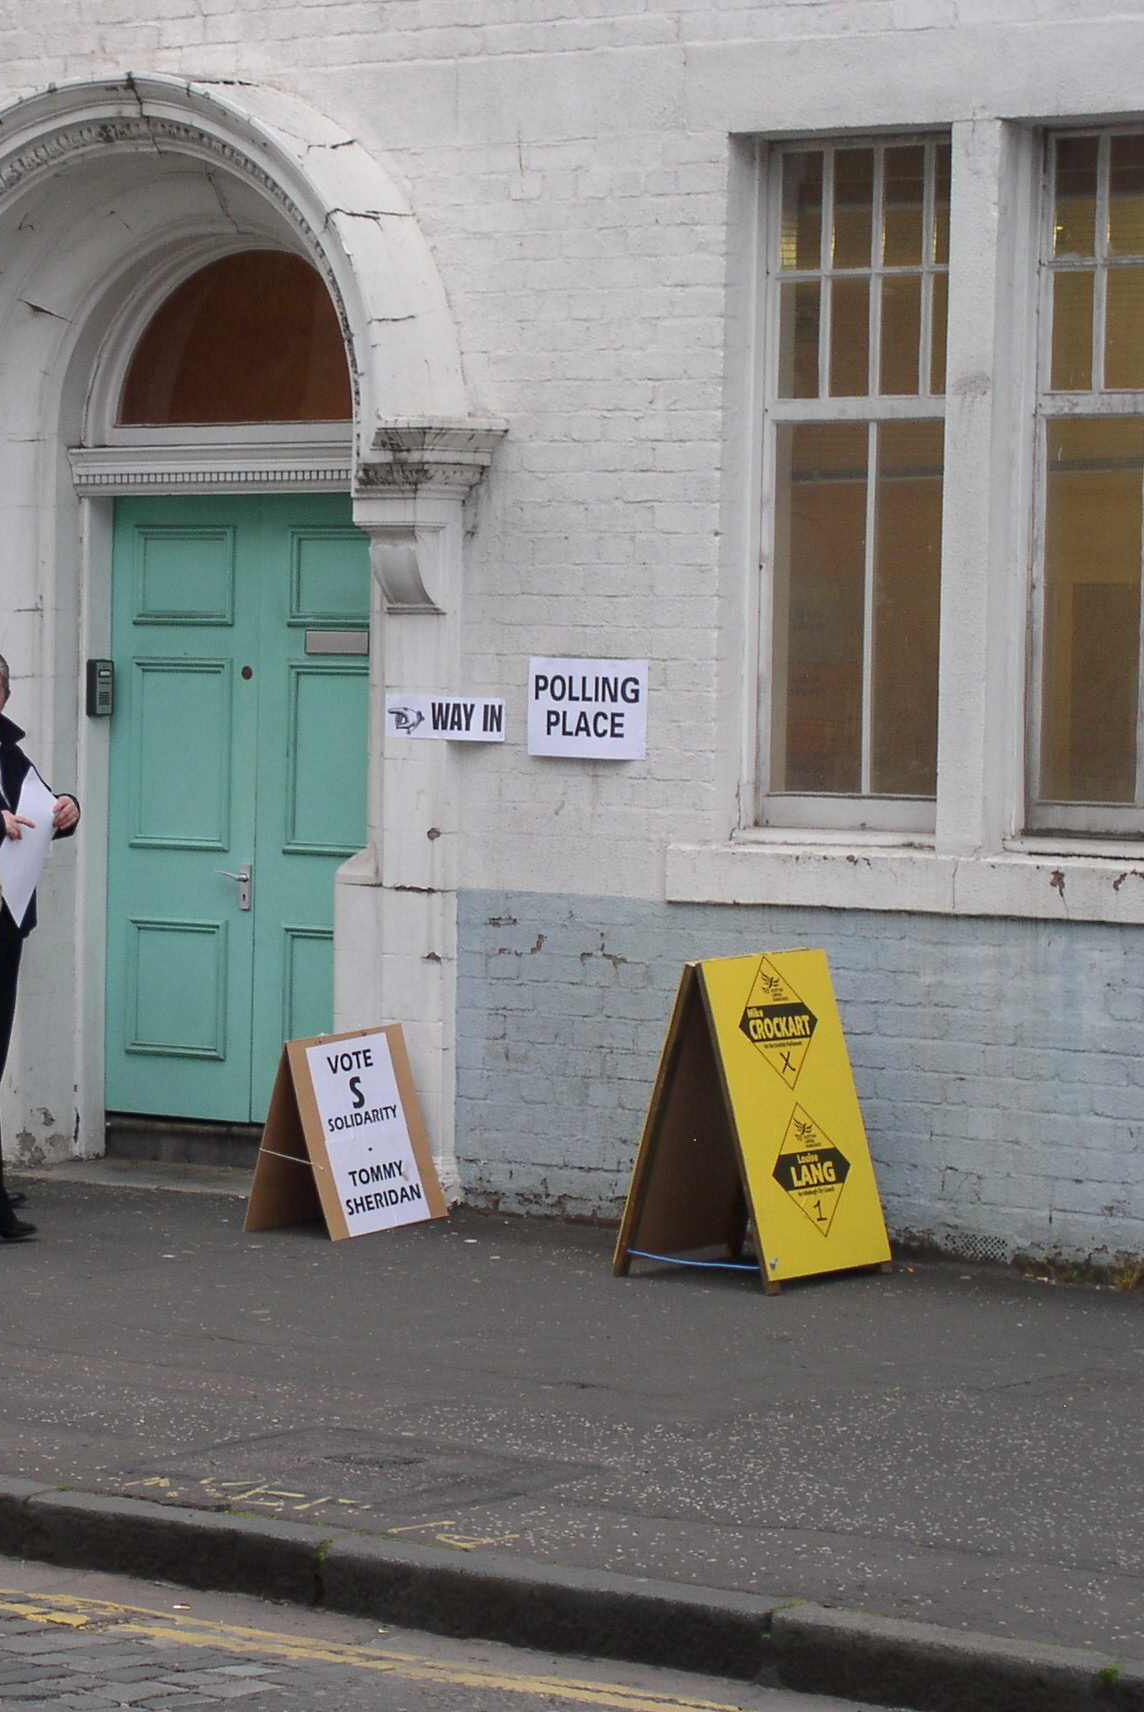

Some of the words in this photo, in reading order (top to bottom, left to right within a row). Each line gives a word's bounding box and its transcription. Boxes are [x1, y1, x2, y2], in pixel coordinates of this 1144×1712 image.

[534, 674, 640, 703] POLLING
[431, 702, 475, 732] WAY
[482, 704, 503, 733] IN
[546, 710, 625, 738] PLACE
[748, 1014, 811, 1041] CROCKART
[327, 1049, 374, 1074] VOTE
[349, 1076, 365, 1109] S
[328, 1105, 398, 1132] SOLIDARITY
[348, 1160, 404, 1187] TOMMY
[790, 1161, 836, 1188] LANG
[345, 1183, 422, 1216] SHERIDAN
